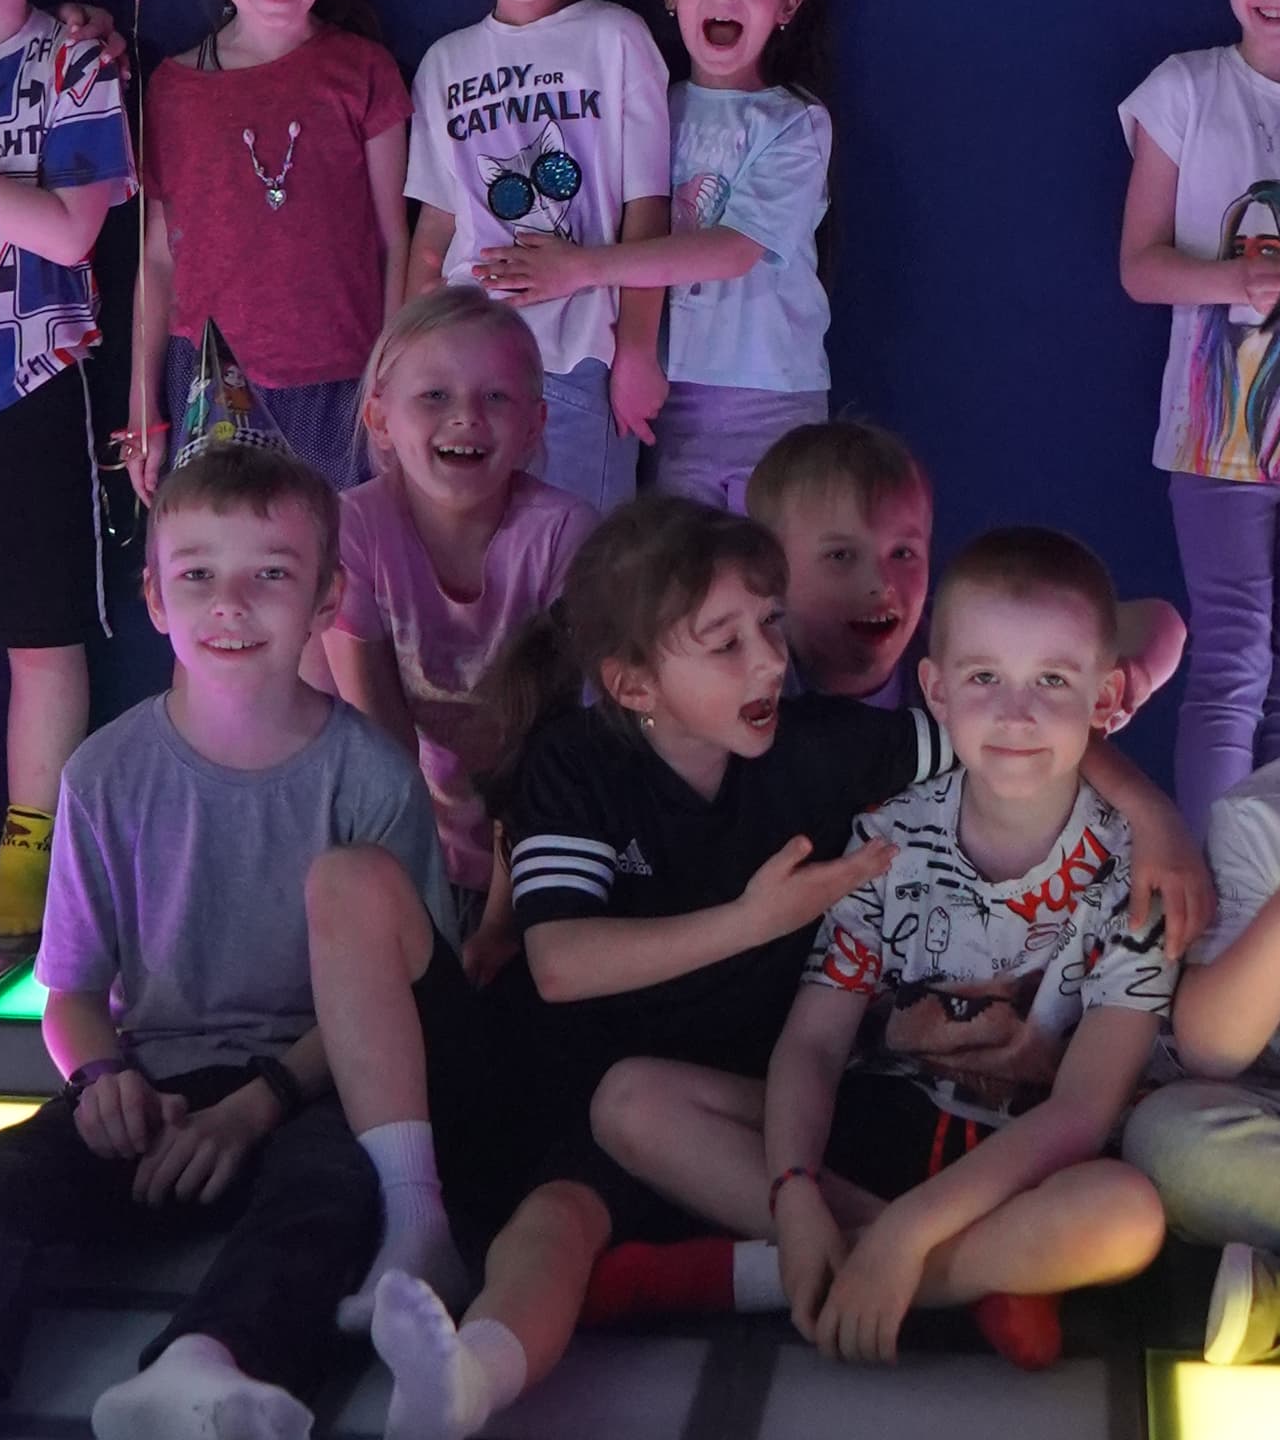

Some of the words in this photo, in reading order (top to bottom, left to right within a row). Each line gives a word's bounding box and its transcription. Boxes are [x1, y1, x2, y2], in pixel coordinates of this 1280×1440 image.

[447, 63, 533, 110] READY
[533, 71, 565, 87] FOR
[446, 88, 601, 141] CATWALK
